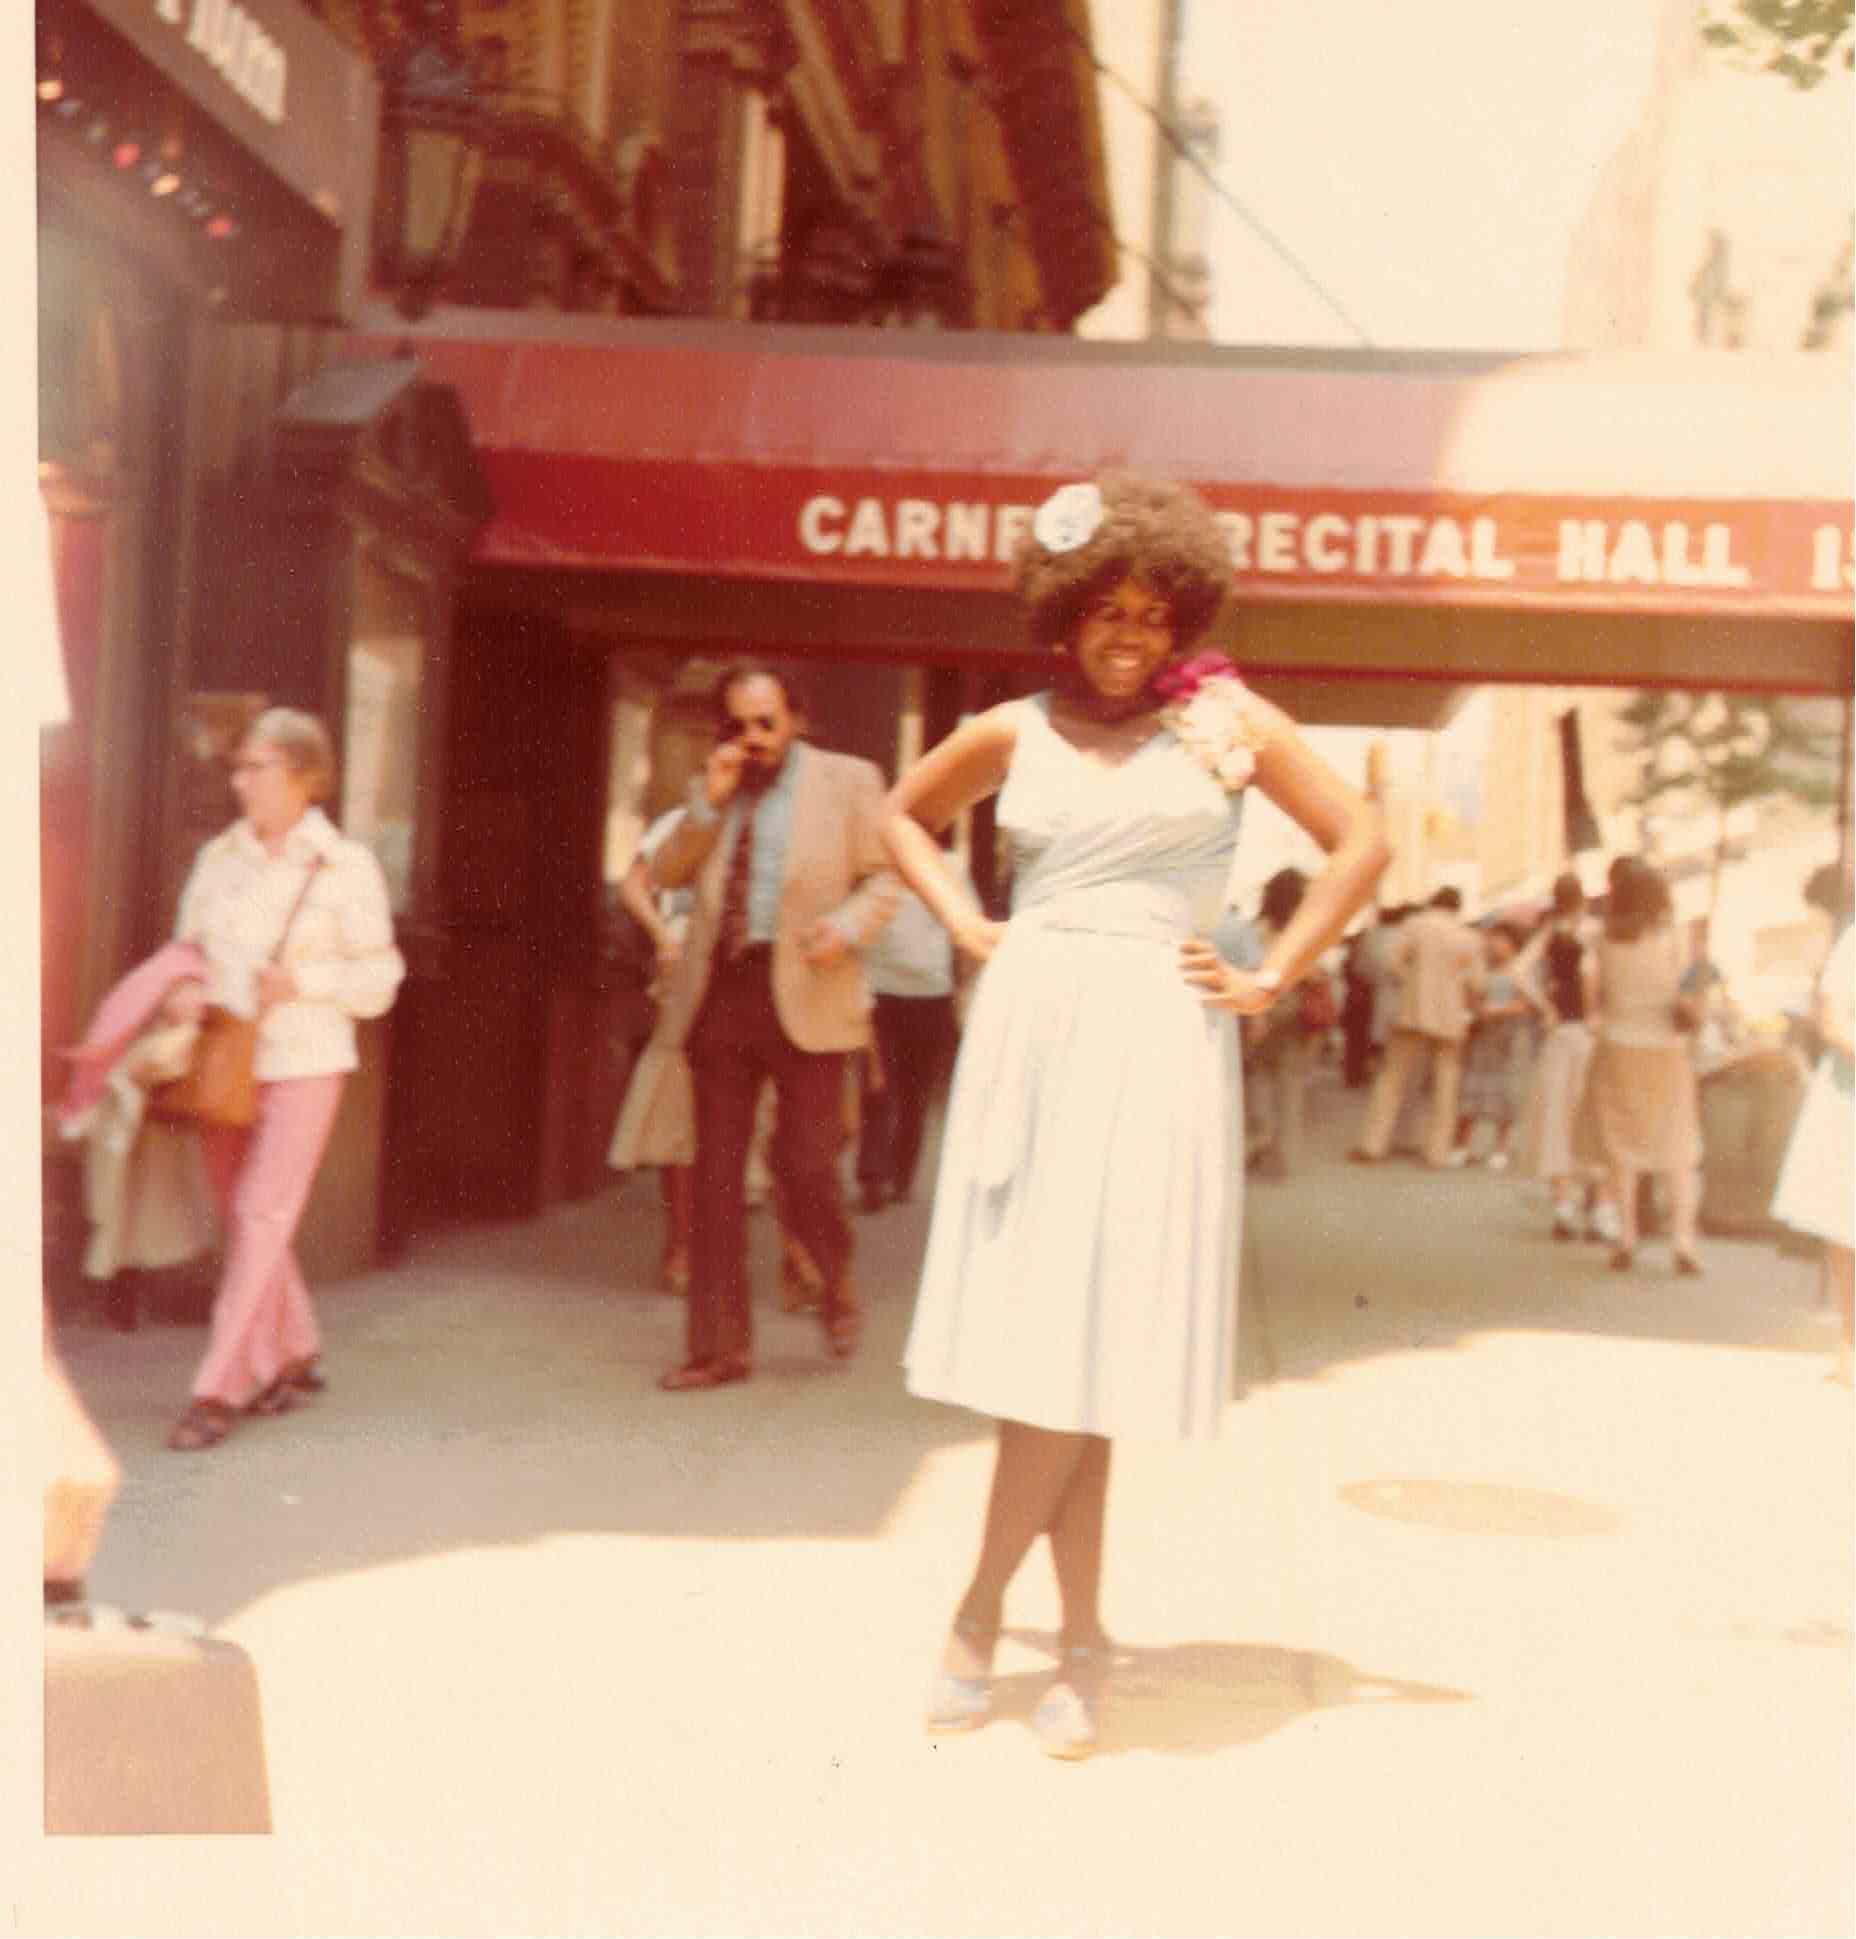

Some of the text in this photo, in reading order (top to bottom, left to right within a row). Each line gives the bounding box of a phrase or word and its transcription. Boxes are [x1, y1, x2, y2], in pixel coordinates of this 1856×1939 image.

[800, 496, 1855, 591] CARNE RECITAL HALL 1
